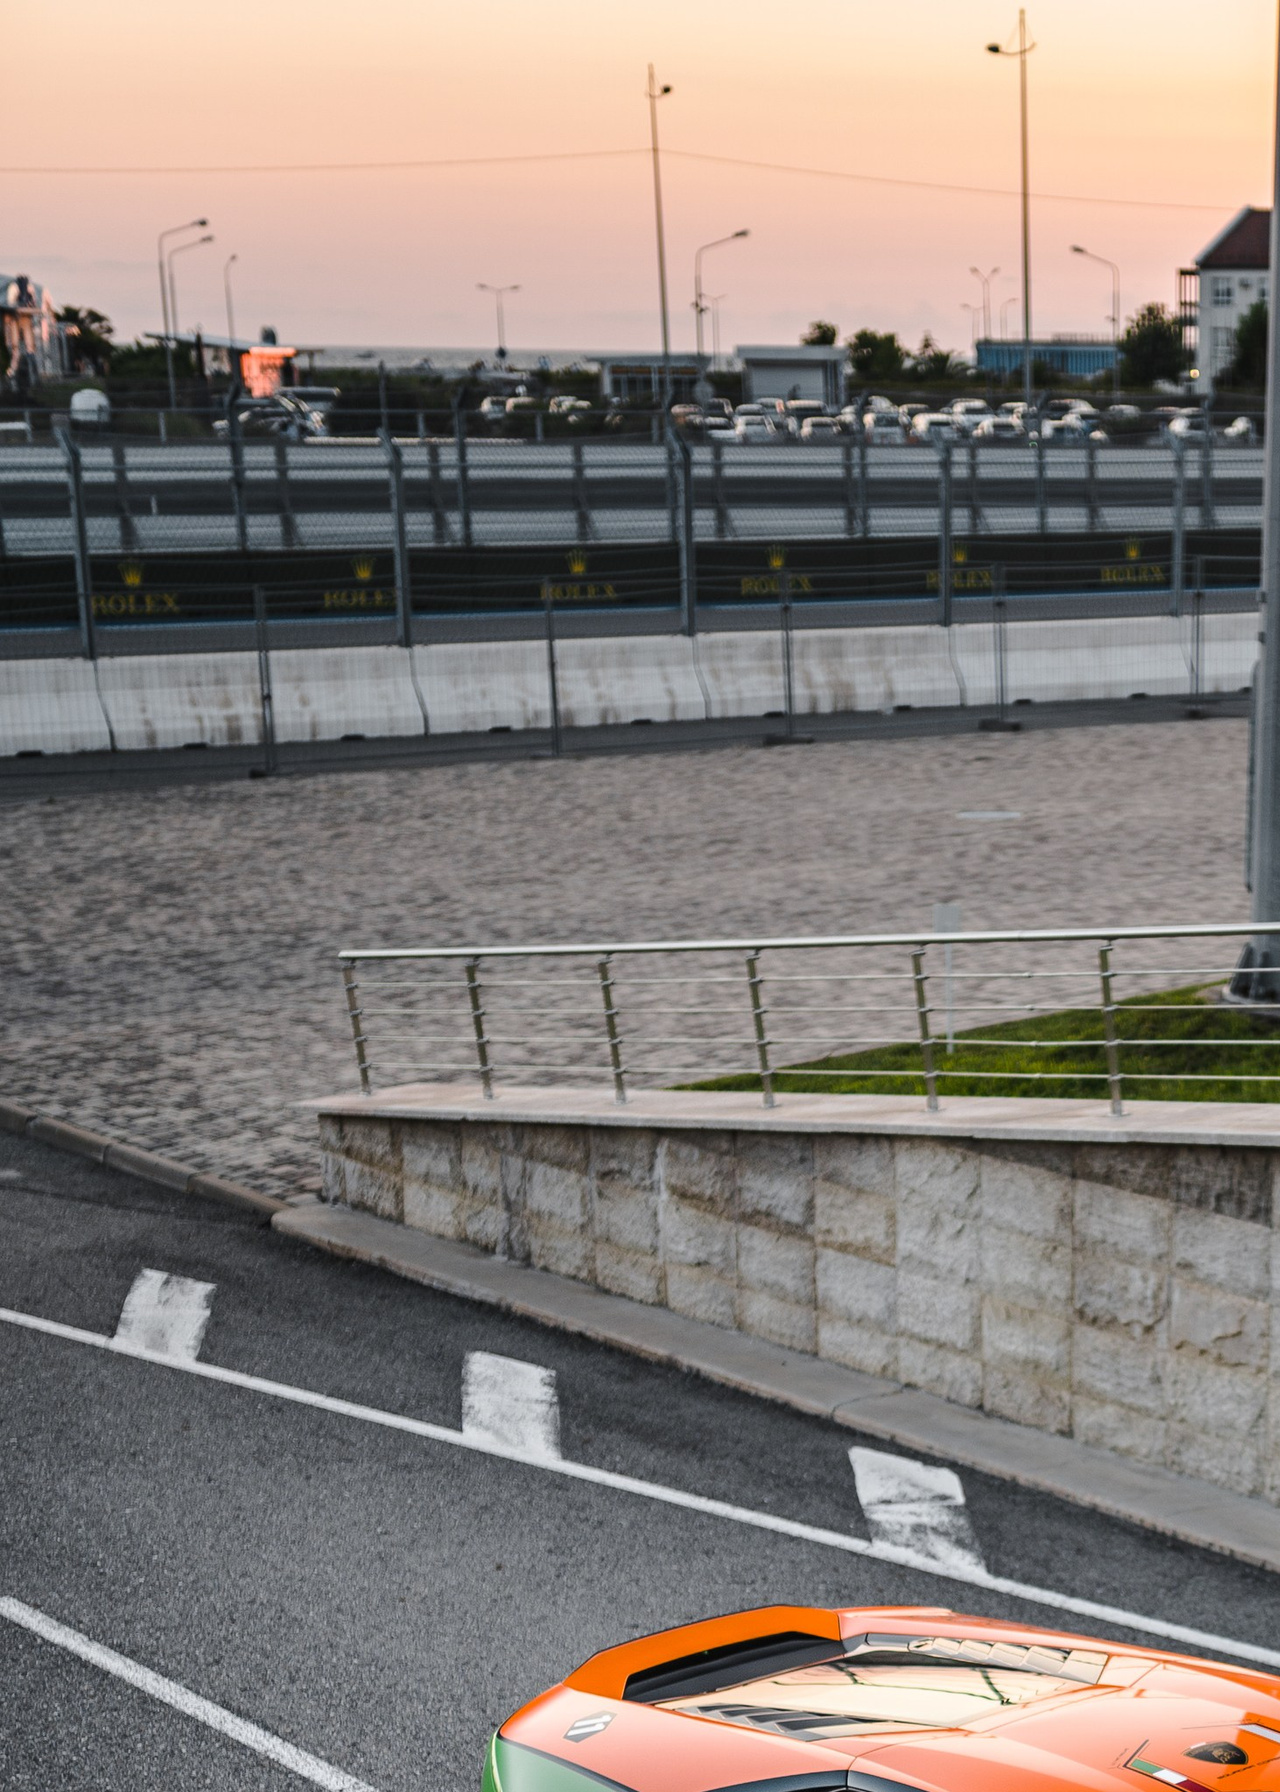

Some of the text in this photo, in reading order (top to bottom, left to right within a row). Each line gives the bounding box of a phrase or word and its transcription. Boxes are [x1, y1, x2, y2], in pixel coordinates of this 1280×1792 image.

[926, 569, 992, 589] RLEX
[91, 592, 181, 616] ROLEX
[324, 588, 396, 610] ROLE
